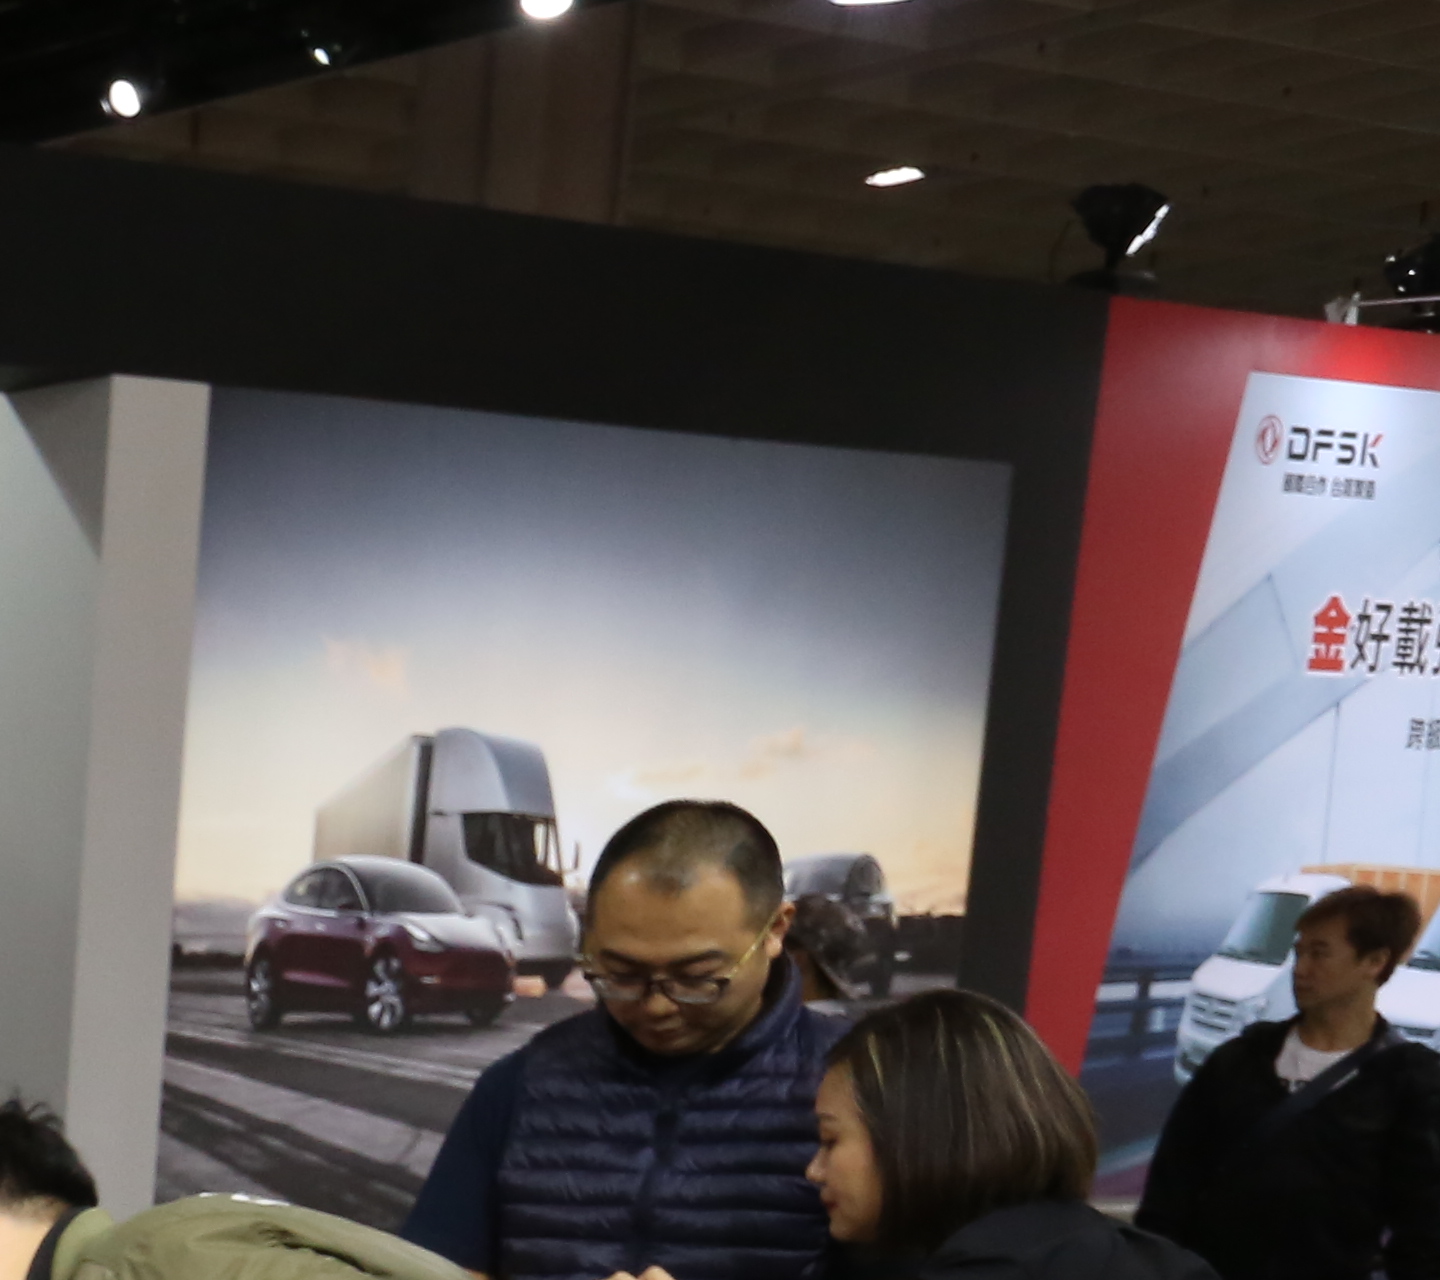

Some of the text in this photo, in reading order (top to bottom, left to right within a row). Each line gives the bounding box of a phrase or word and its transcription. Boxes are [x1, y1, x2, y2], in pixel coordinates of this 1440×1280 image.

[1287, 426, 1384, 469] DFSK
[1307, 594, 1440, 676] 金好載
